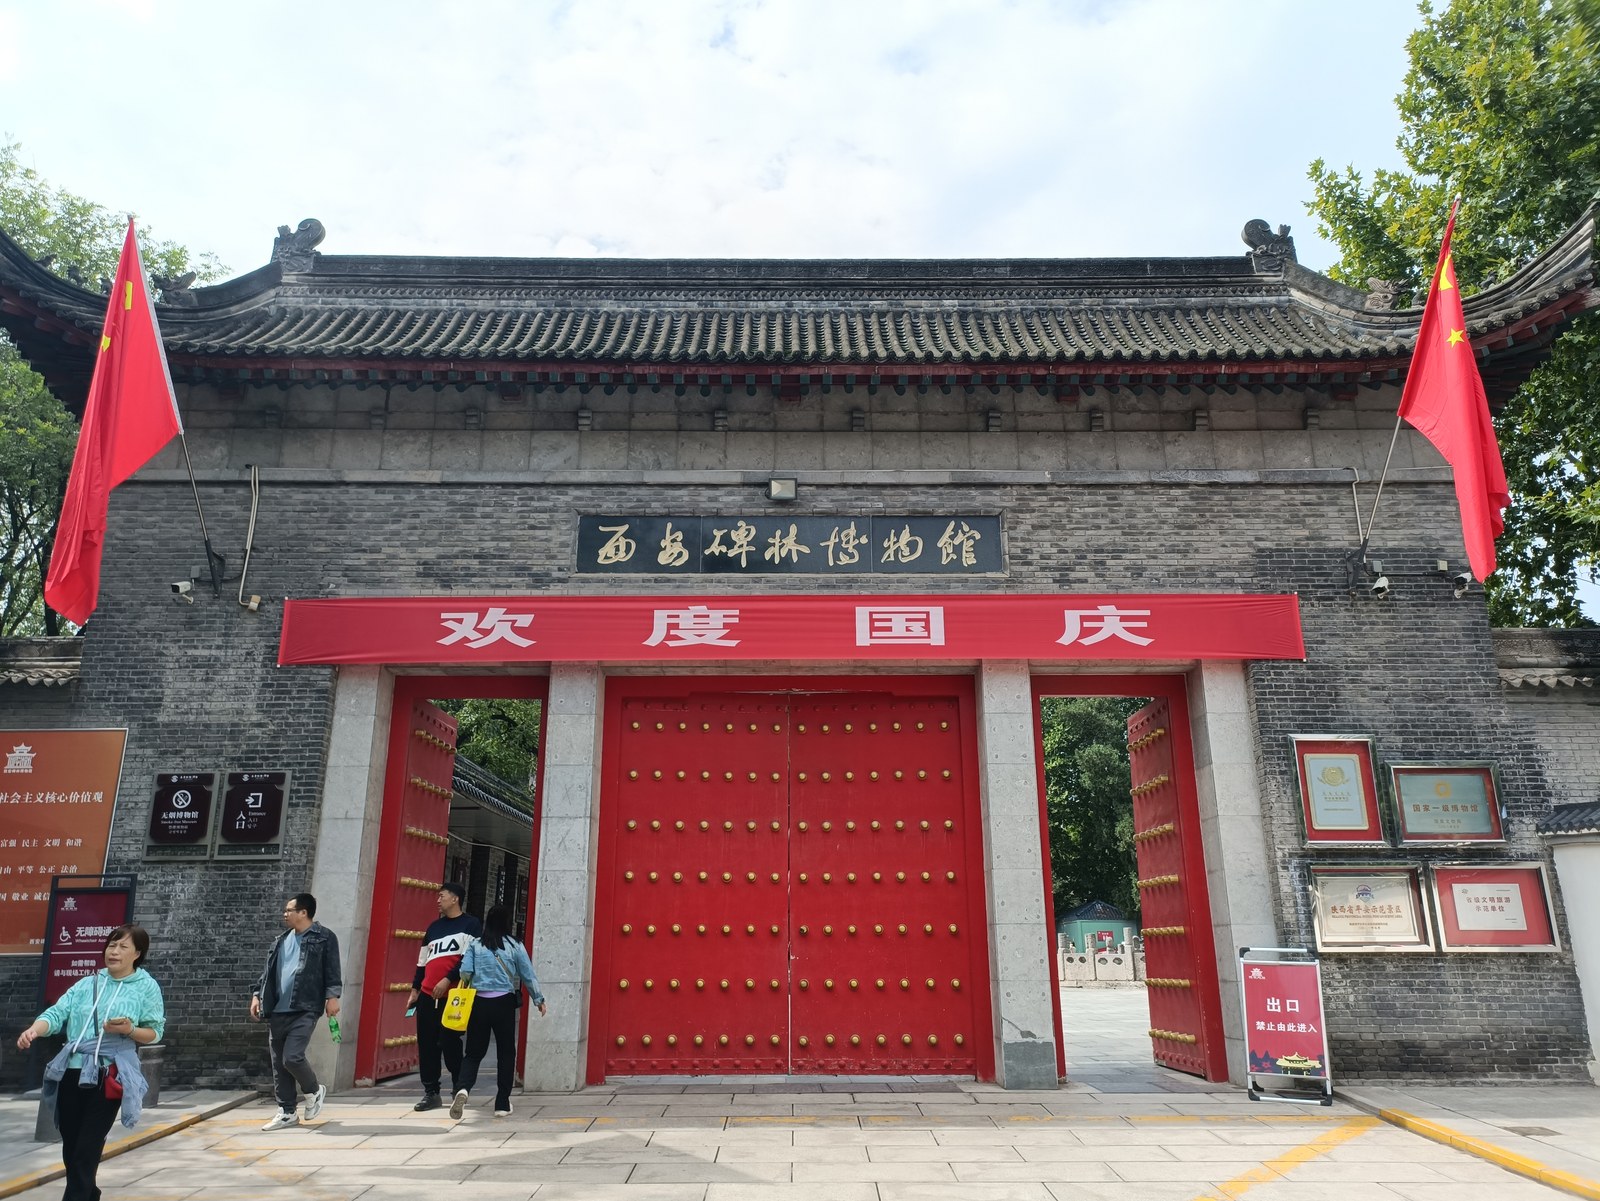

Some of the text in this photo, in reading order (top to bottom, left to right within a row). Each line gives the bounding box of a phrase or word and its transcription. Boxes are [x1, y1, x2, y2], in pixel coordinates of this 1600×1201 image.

[437, 605, 1153, 649] 欢度国庆
[0, 791, 104, 804] 社会主义核心价值观
[161, 811, 199, 819] 无烟博物馆
[236, 810, 246, 829] 入口
[0, 838, 82, 847] 富强 民主 文明 和谐
[0, 865, 78, 874] 由 平等 公正 法治
[427, 938, 460, 958] FILA
[1266, 997, 1300, 1013] 出口
[1255, 1021, 1318, 1034] 禁止由此进入
